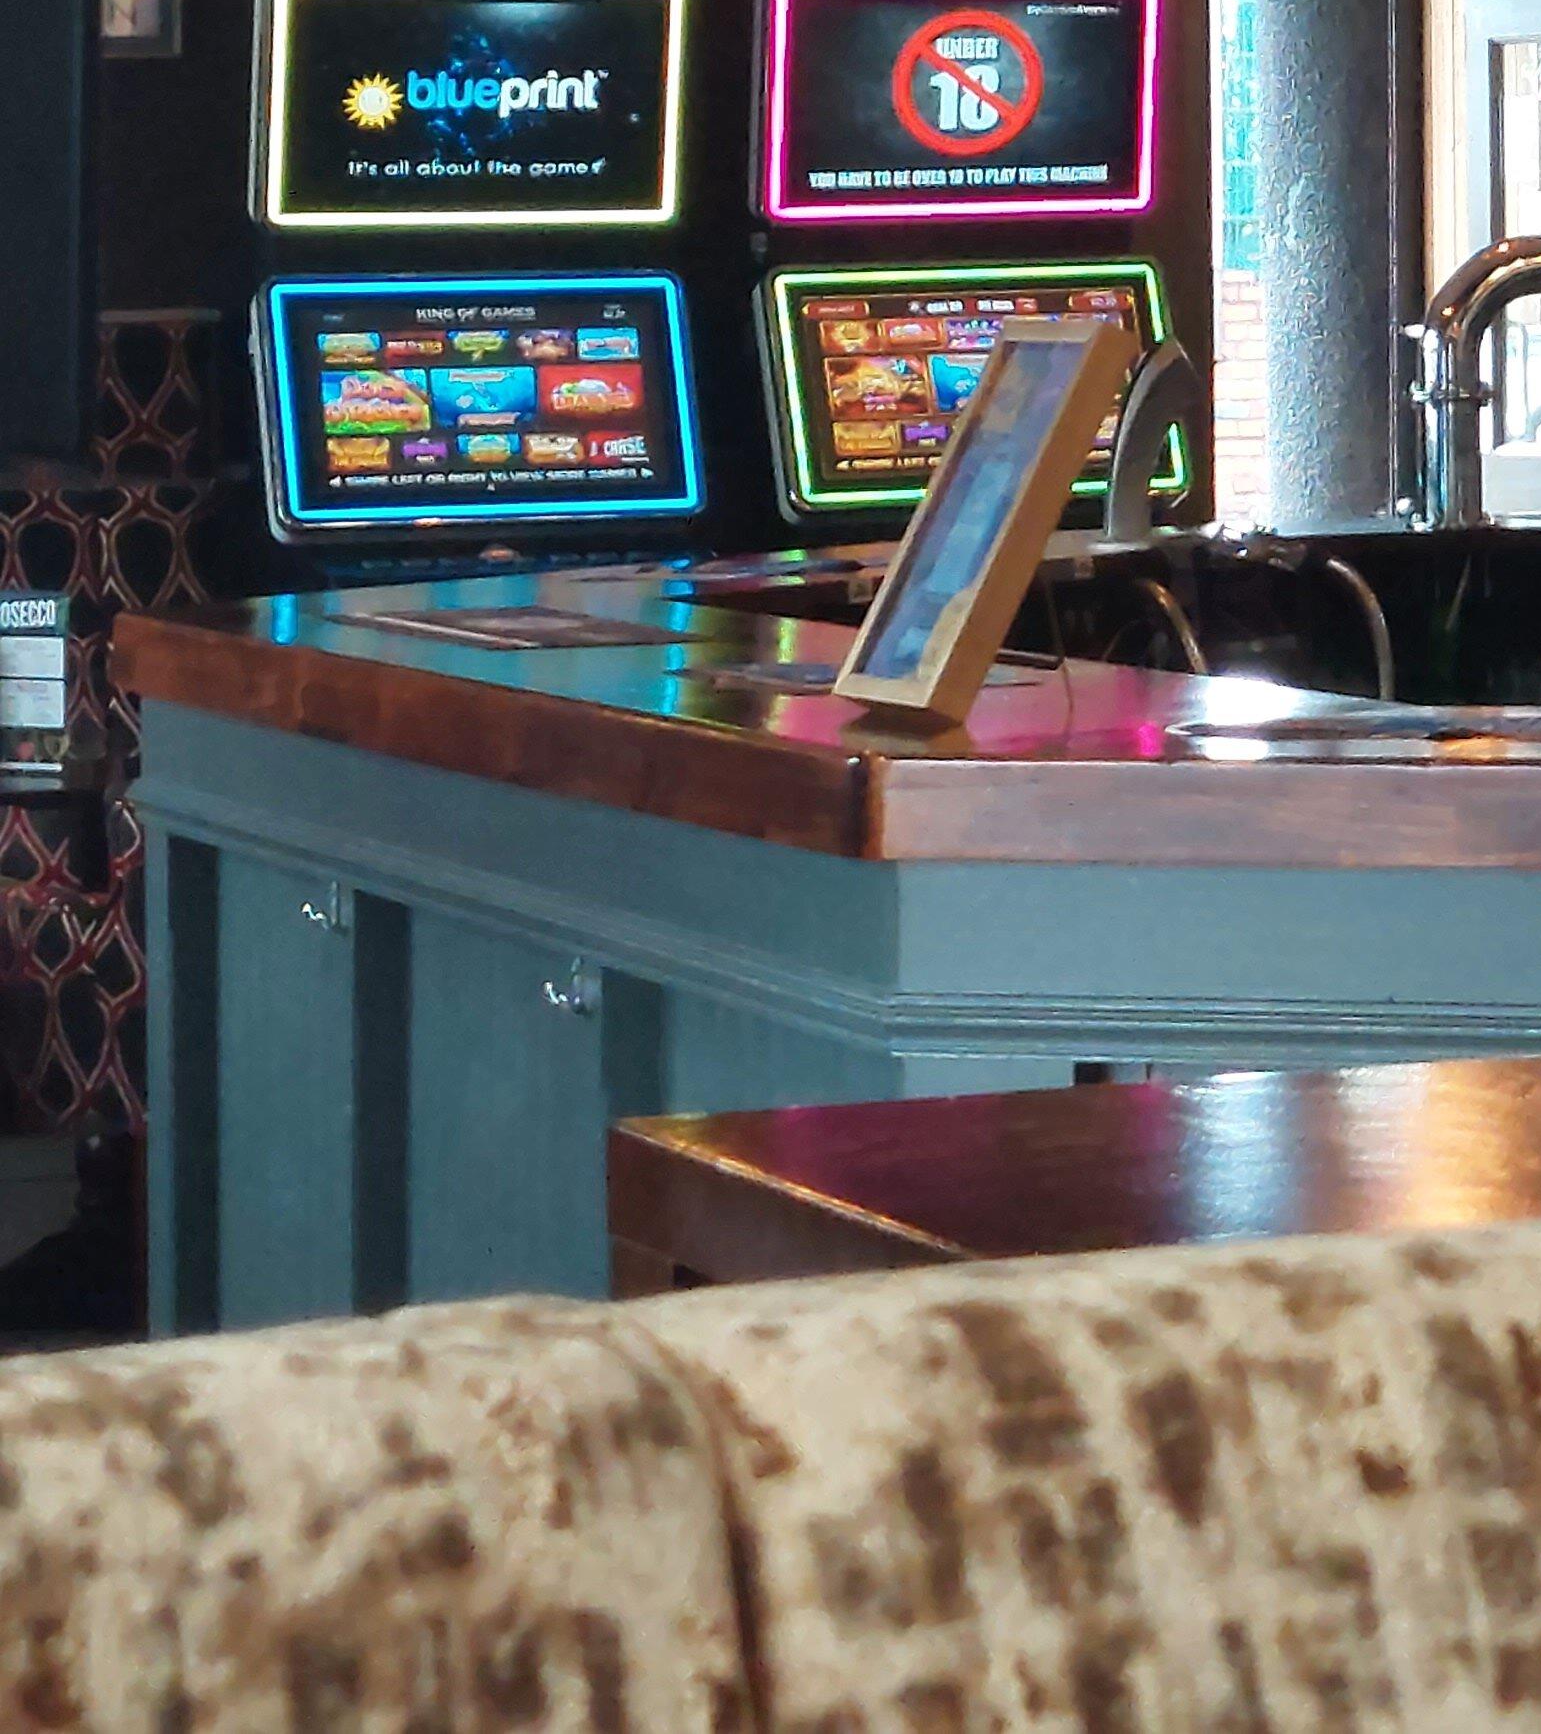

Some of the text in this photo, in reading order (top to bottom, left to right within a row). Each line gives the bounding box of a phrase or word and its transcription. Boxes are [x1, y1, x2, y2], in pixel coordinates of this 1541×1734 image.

[929, 64, 1000, 132] 18
[384, 159, 410, 176] all
[416, 157, 480, 178] about
